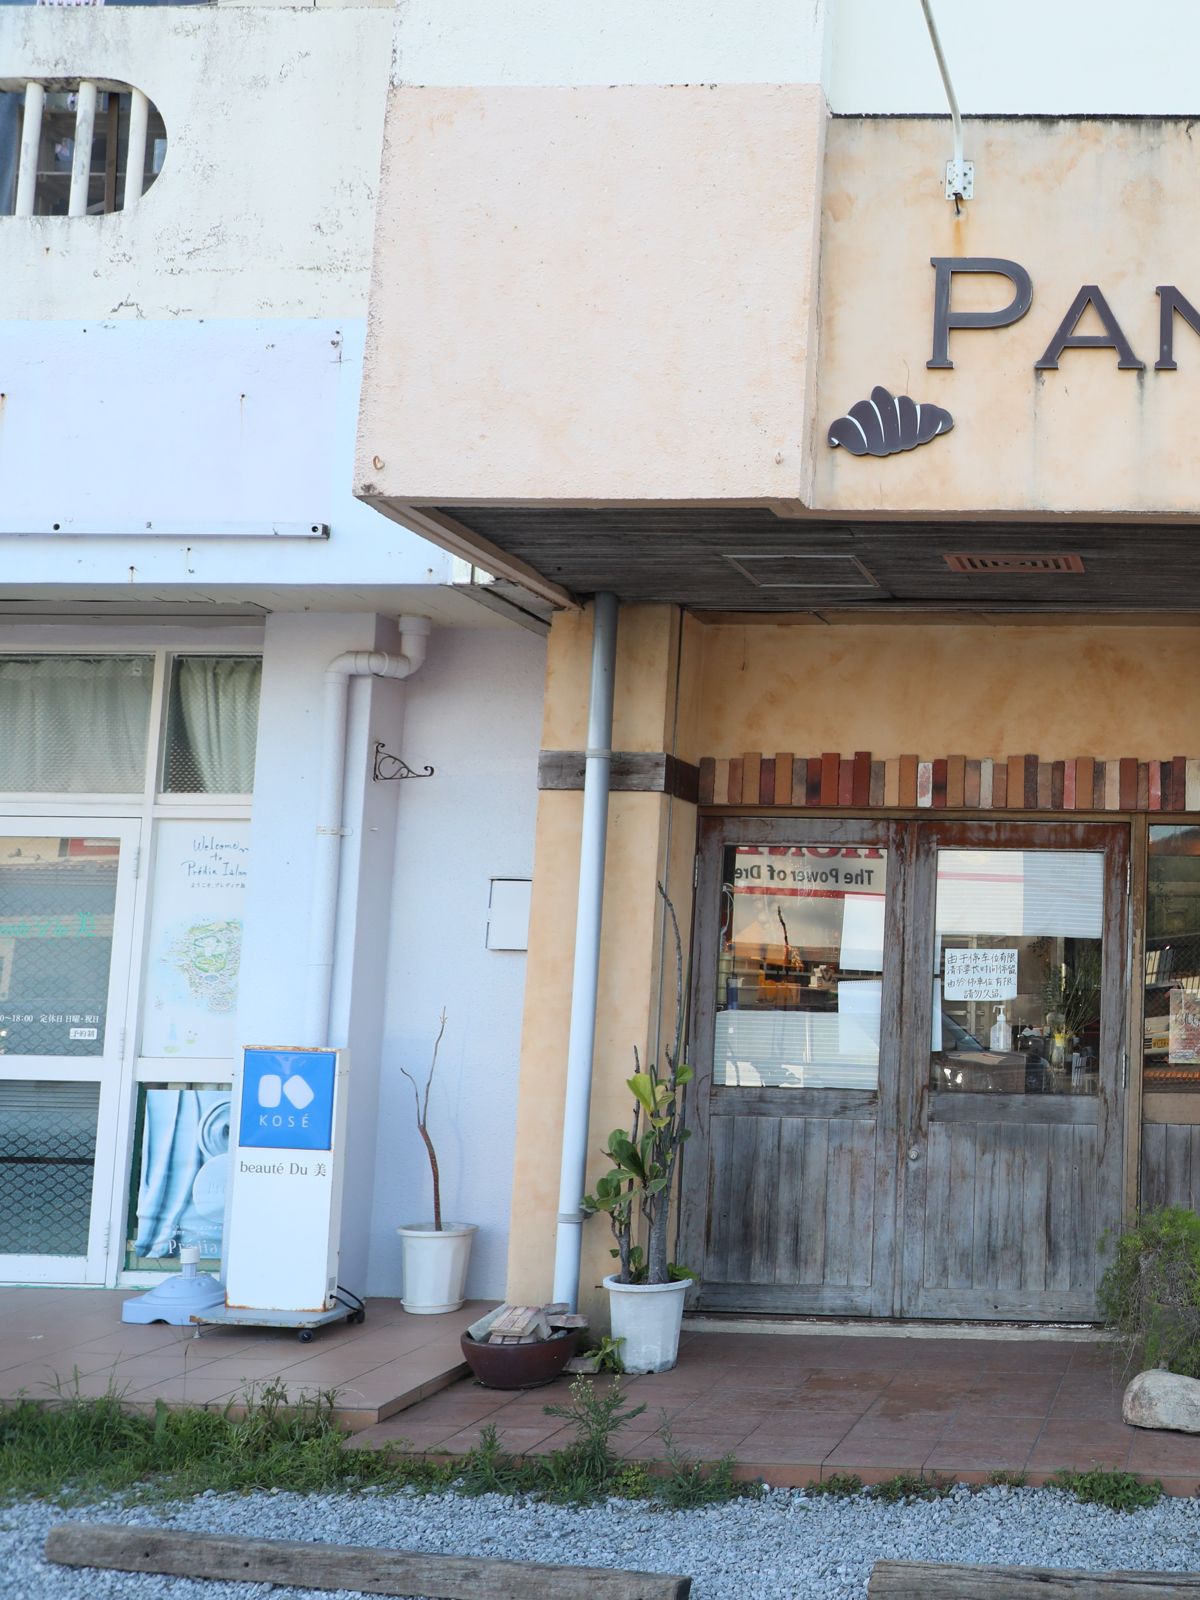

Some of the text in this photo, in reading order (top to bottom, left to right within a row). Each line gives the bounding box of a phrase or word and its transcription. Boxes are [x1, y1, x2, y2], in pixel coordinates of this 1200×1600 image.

[193, 835, 239, 851] Welcome
[40, 1014, 63, 1023] 定休日
[259, 1113, 309, 1128] KOSÉ
[240, 1161, 326, 1176] beauté Du 美
